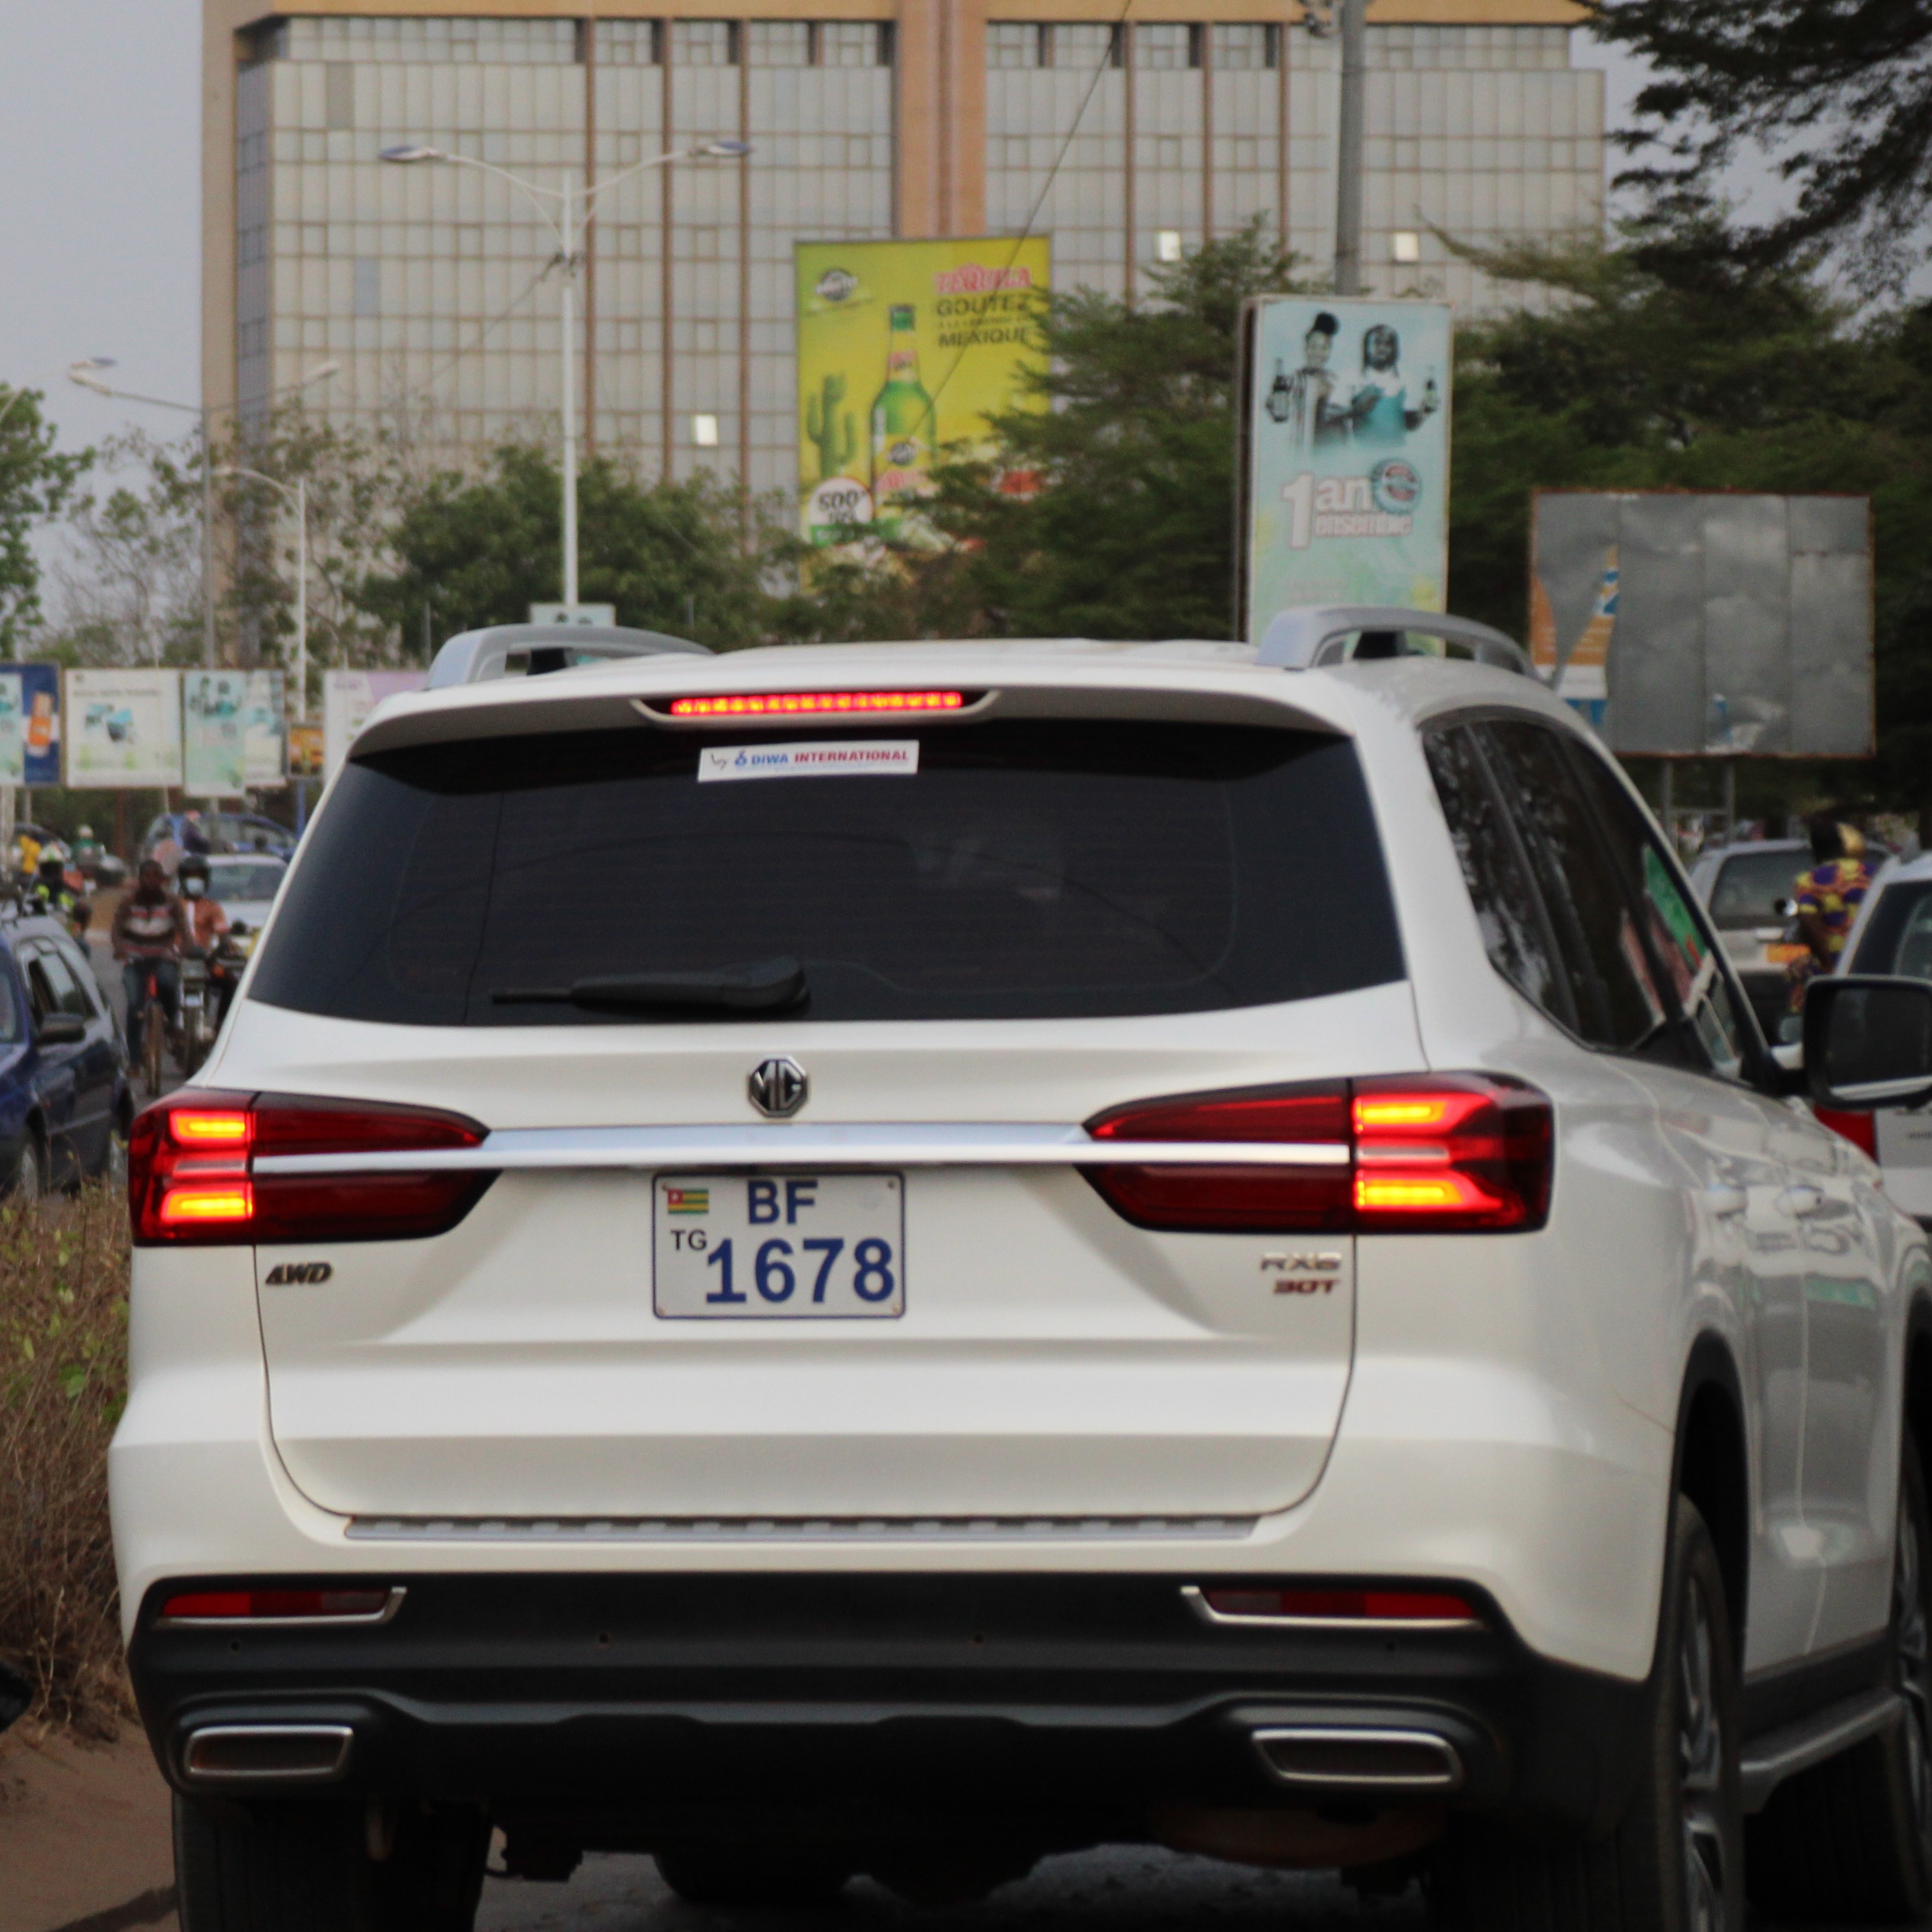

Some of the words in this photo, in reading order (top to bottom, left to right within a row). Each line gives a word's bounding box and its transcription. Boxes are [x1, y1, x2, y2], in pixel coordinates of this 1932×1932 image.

[1282, 470, 1315, 551] 1
[752, 753, 789, 765] DIWA
[794, 749, 909, 763] INTERNATIONAL
[748, 1179, 818, 1225] BF
[670, 1229, 708, 1251] TG
[706, 1237, 895, 1305] 1678
